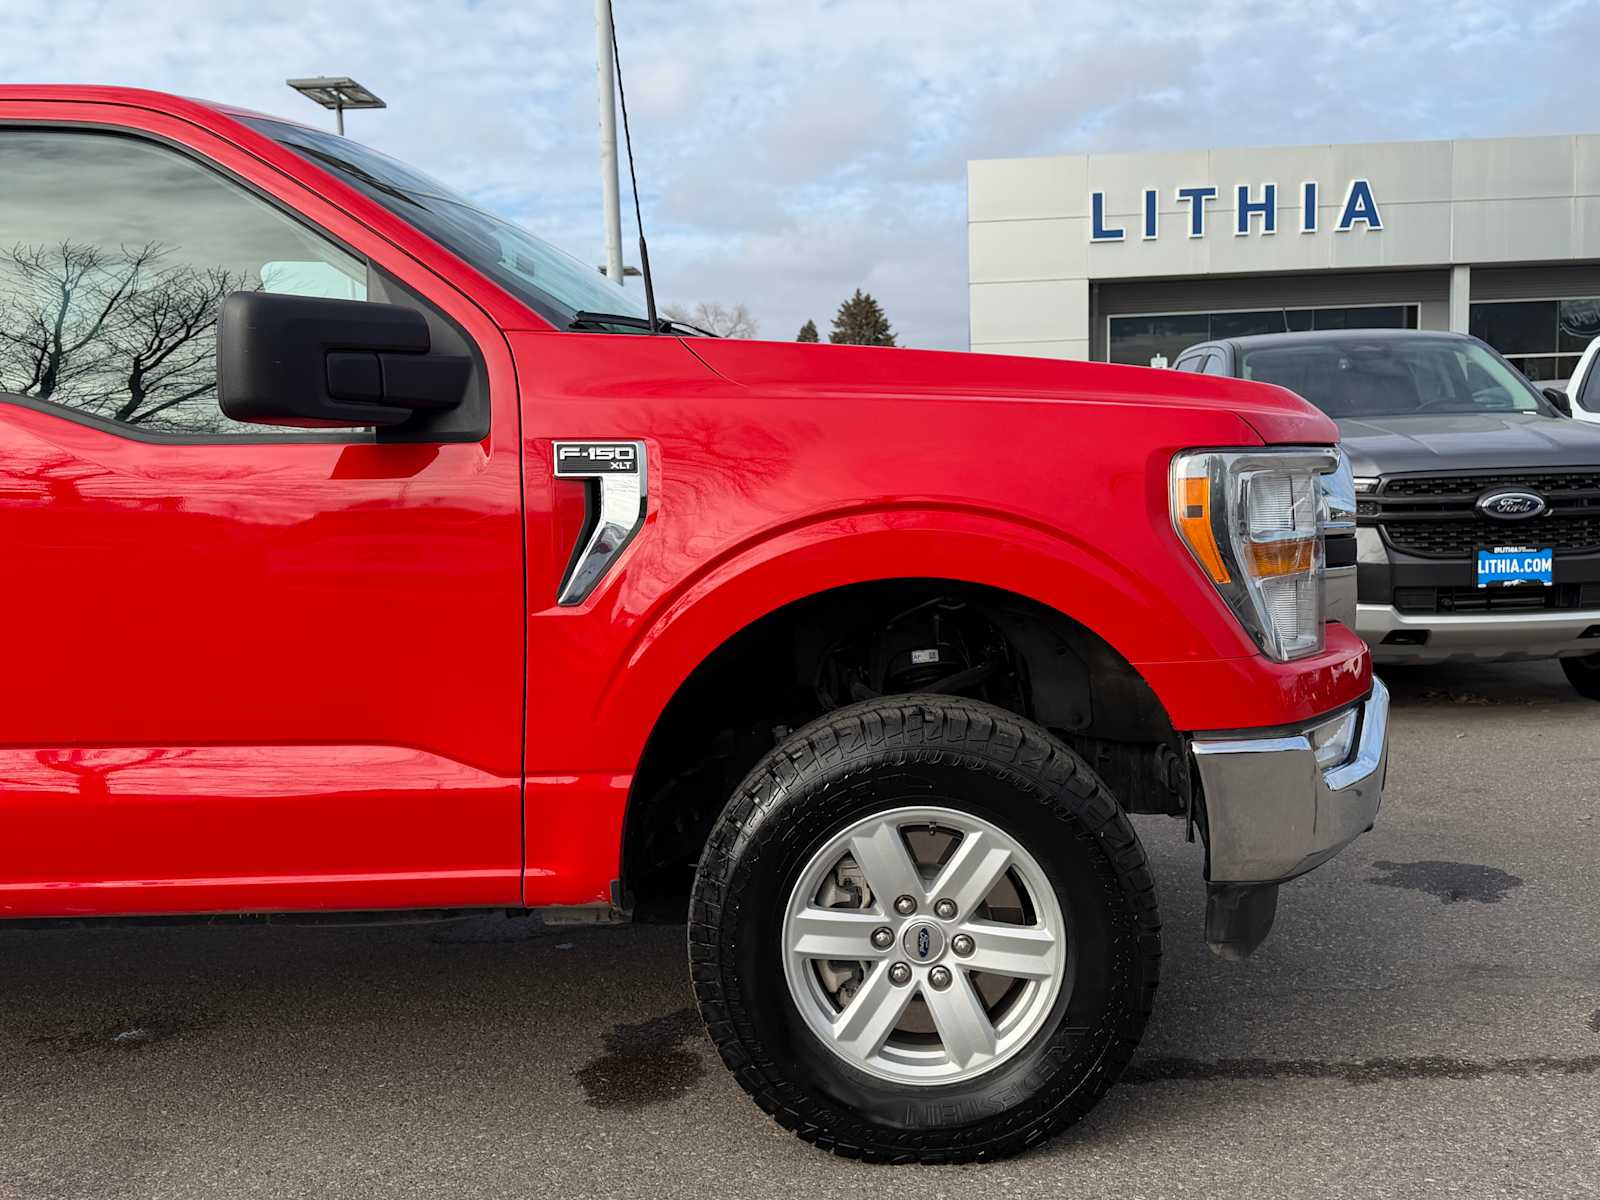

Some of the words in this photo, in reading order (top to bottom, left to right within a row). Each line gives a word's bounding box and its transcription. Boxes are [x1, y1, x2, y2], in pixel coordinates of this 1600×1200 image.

[1089, 179, 1383, 243] LITHIA
[560, 447, 634, 460] F-150
[610, 461, 632, 470] XLT
[1497, 498, 1531, 513] Ford
[1478, 558, 1552, 574] LITHIA.COM
